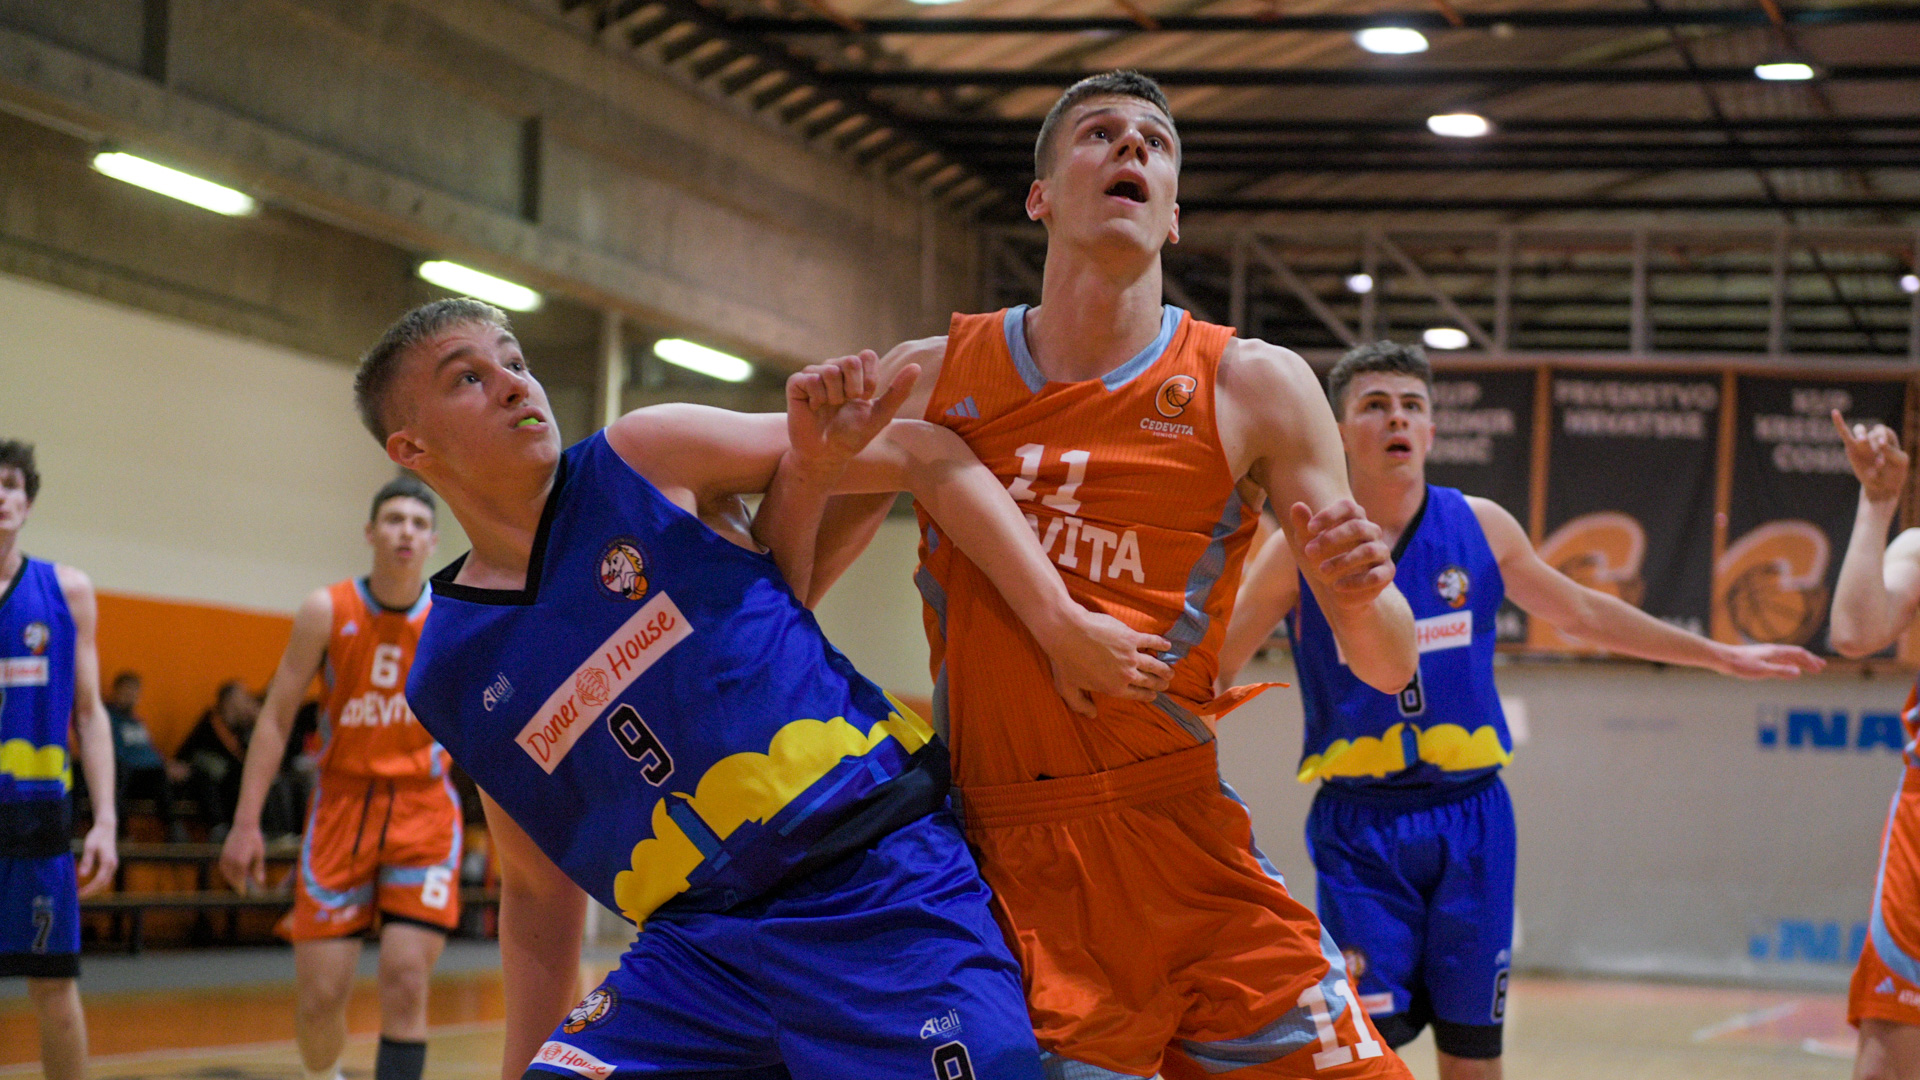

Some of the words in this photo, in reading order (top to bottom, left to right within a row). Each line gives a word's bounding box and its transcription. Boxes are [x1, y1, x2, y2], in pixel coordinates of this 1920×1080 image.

[1139, 417, 1194, 436] CEDEVITA
[1007, 443, 1090, 515] 11
[1416, 620, 1467, 644] House
[371, 643, 402, 689] 6
[526, 695, 580, 763] Doner
[606, 611, 676, 681] House
[483, 671, 511, 712] Atali
[606, 703, 675, 787] 9
[421, 865, 453, 910] 6
[920, 1008, 960, 1040] Atali
[1297, 979, 1384, 1070] 11
